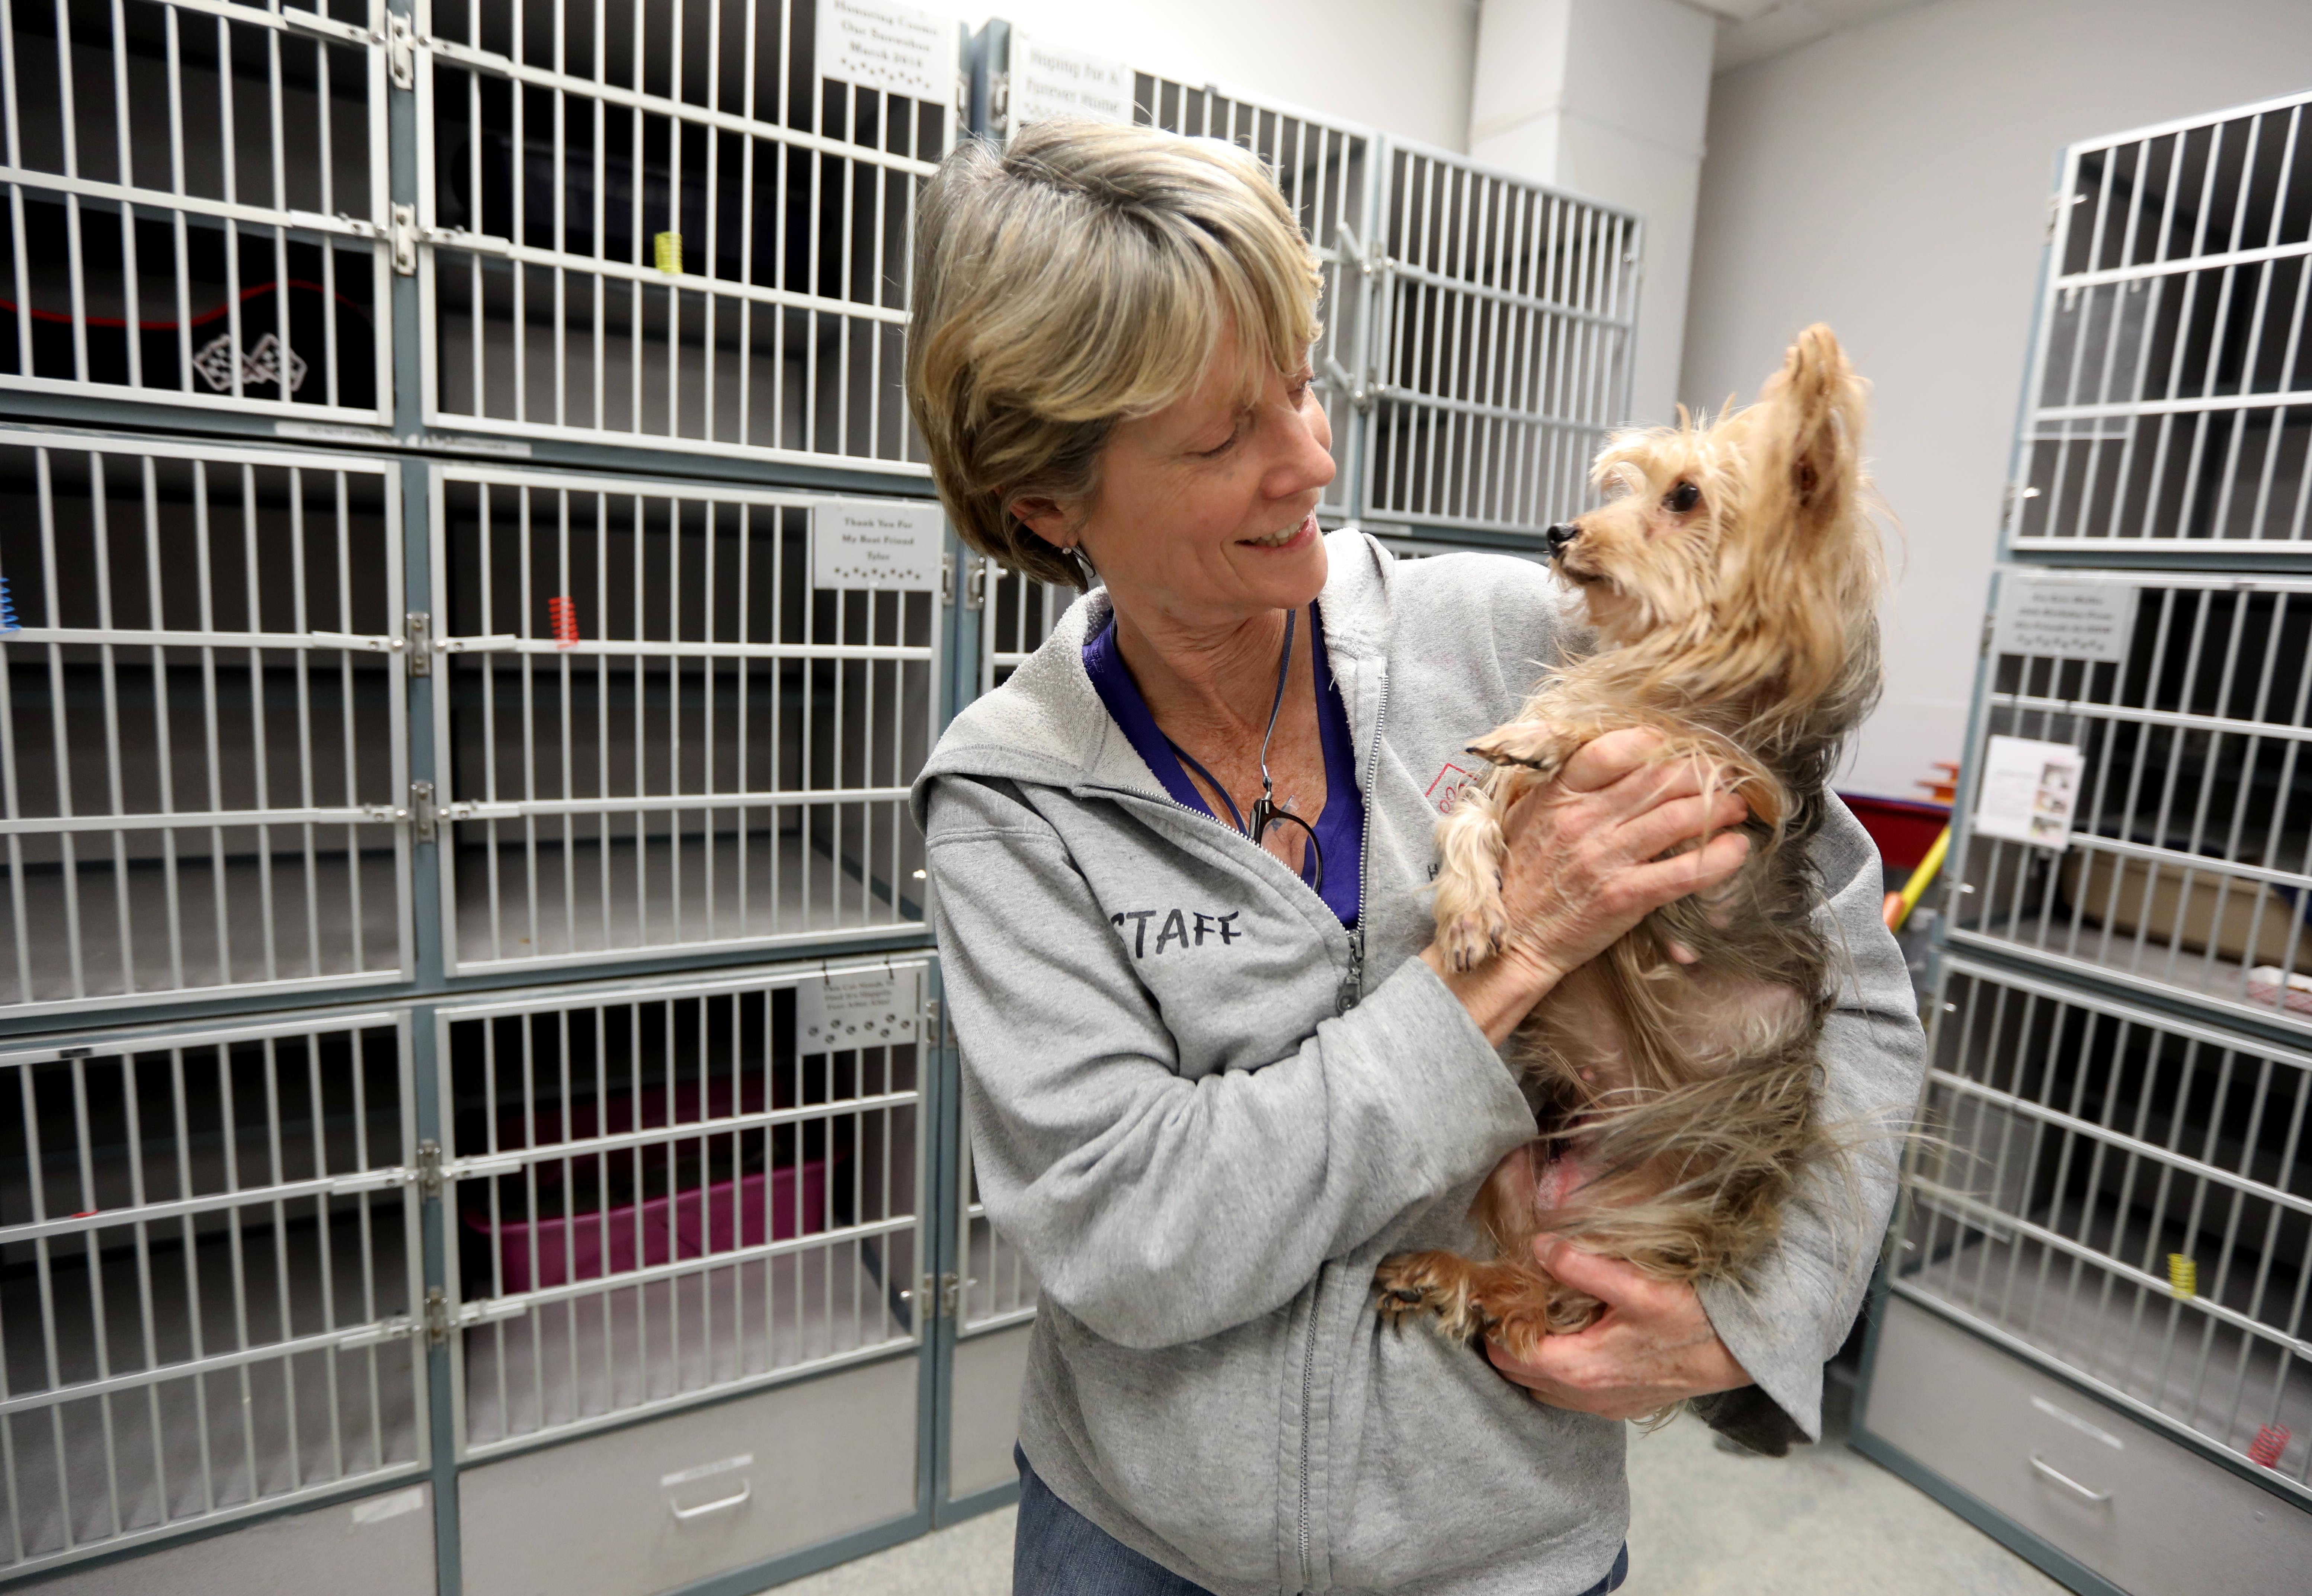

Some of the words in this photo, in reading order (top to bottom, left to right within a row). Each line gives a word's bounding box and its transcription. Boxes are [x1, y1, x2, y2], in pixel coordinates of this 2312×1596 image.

[841, 20, 866, 36] Our
[850, 40, 888, 61] March
[1030, 49, 1080, 79] Hoping
[1084, 63, 1104, 81] For
[1026, 77, 1076, 103] Forever
[1081, 90, 1119, 113] Home
[845, 517, 874, 526] Thank
[878, 519, 894, 528] You
[897, 519, 913, 528] For
[842, 533, 856, 543] My
[860, 535, 881, 544] Best
[884, 536, 915, 545] Friend
[867, 551, 890, 560] Tyler
